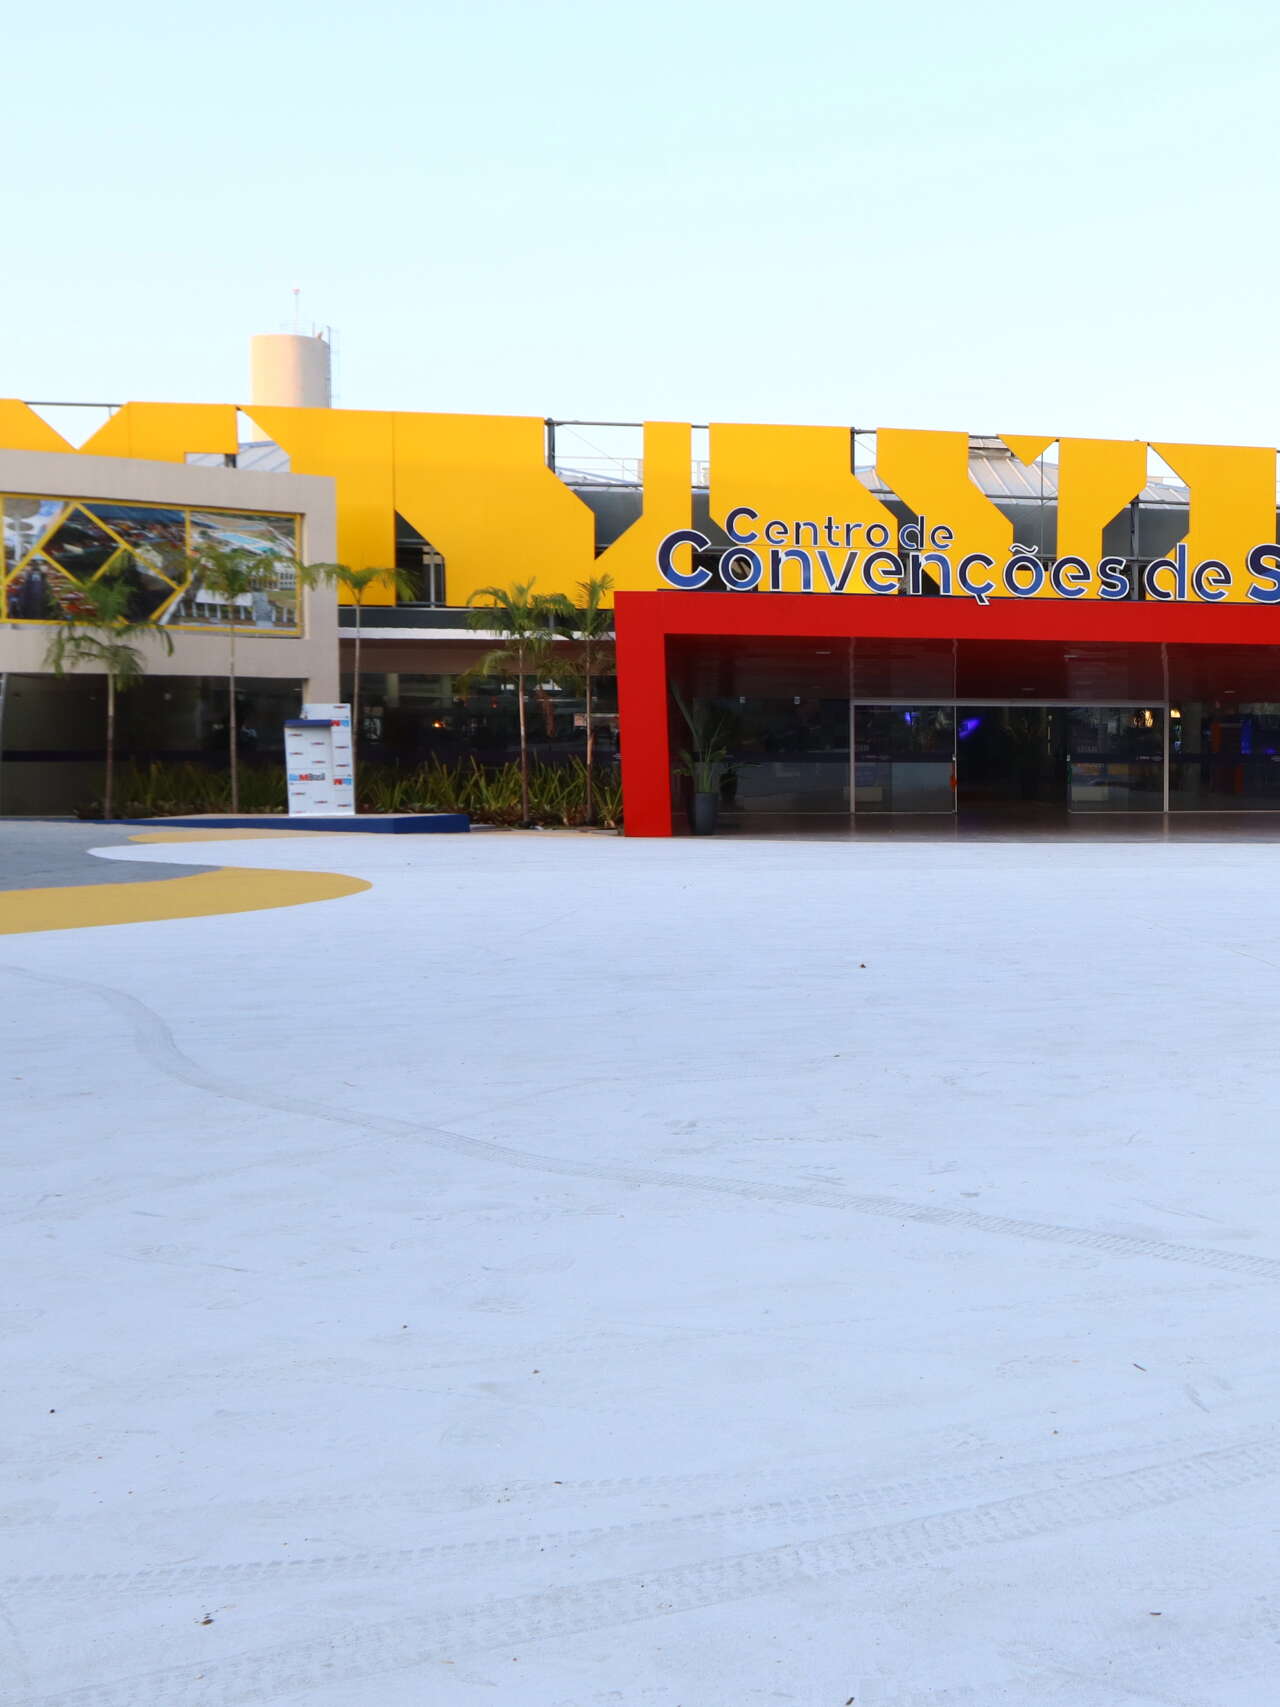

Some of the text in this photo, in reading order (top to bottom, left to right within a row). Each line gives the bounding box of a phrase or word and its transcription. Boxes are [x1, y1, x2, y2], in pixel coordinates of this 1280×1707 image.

[725, 506, 955, 551] Centro de
[656, 528, 1129, 606] Convenções
[1143, 541, 1233, 602] de
